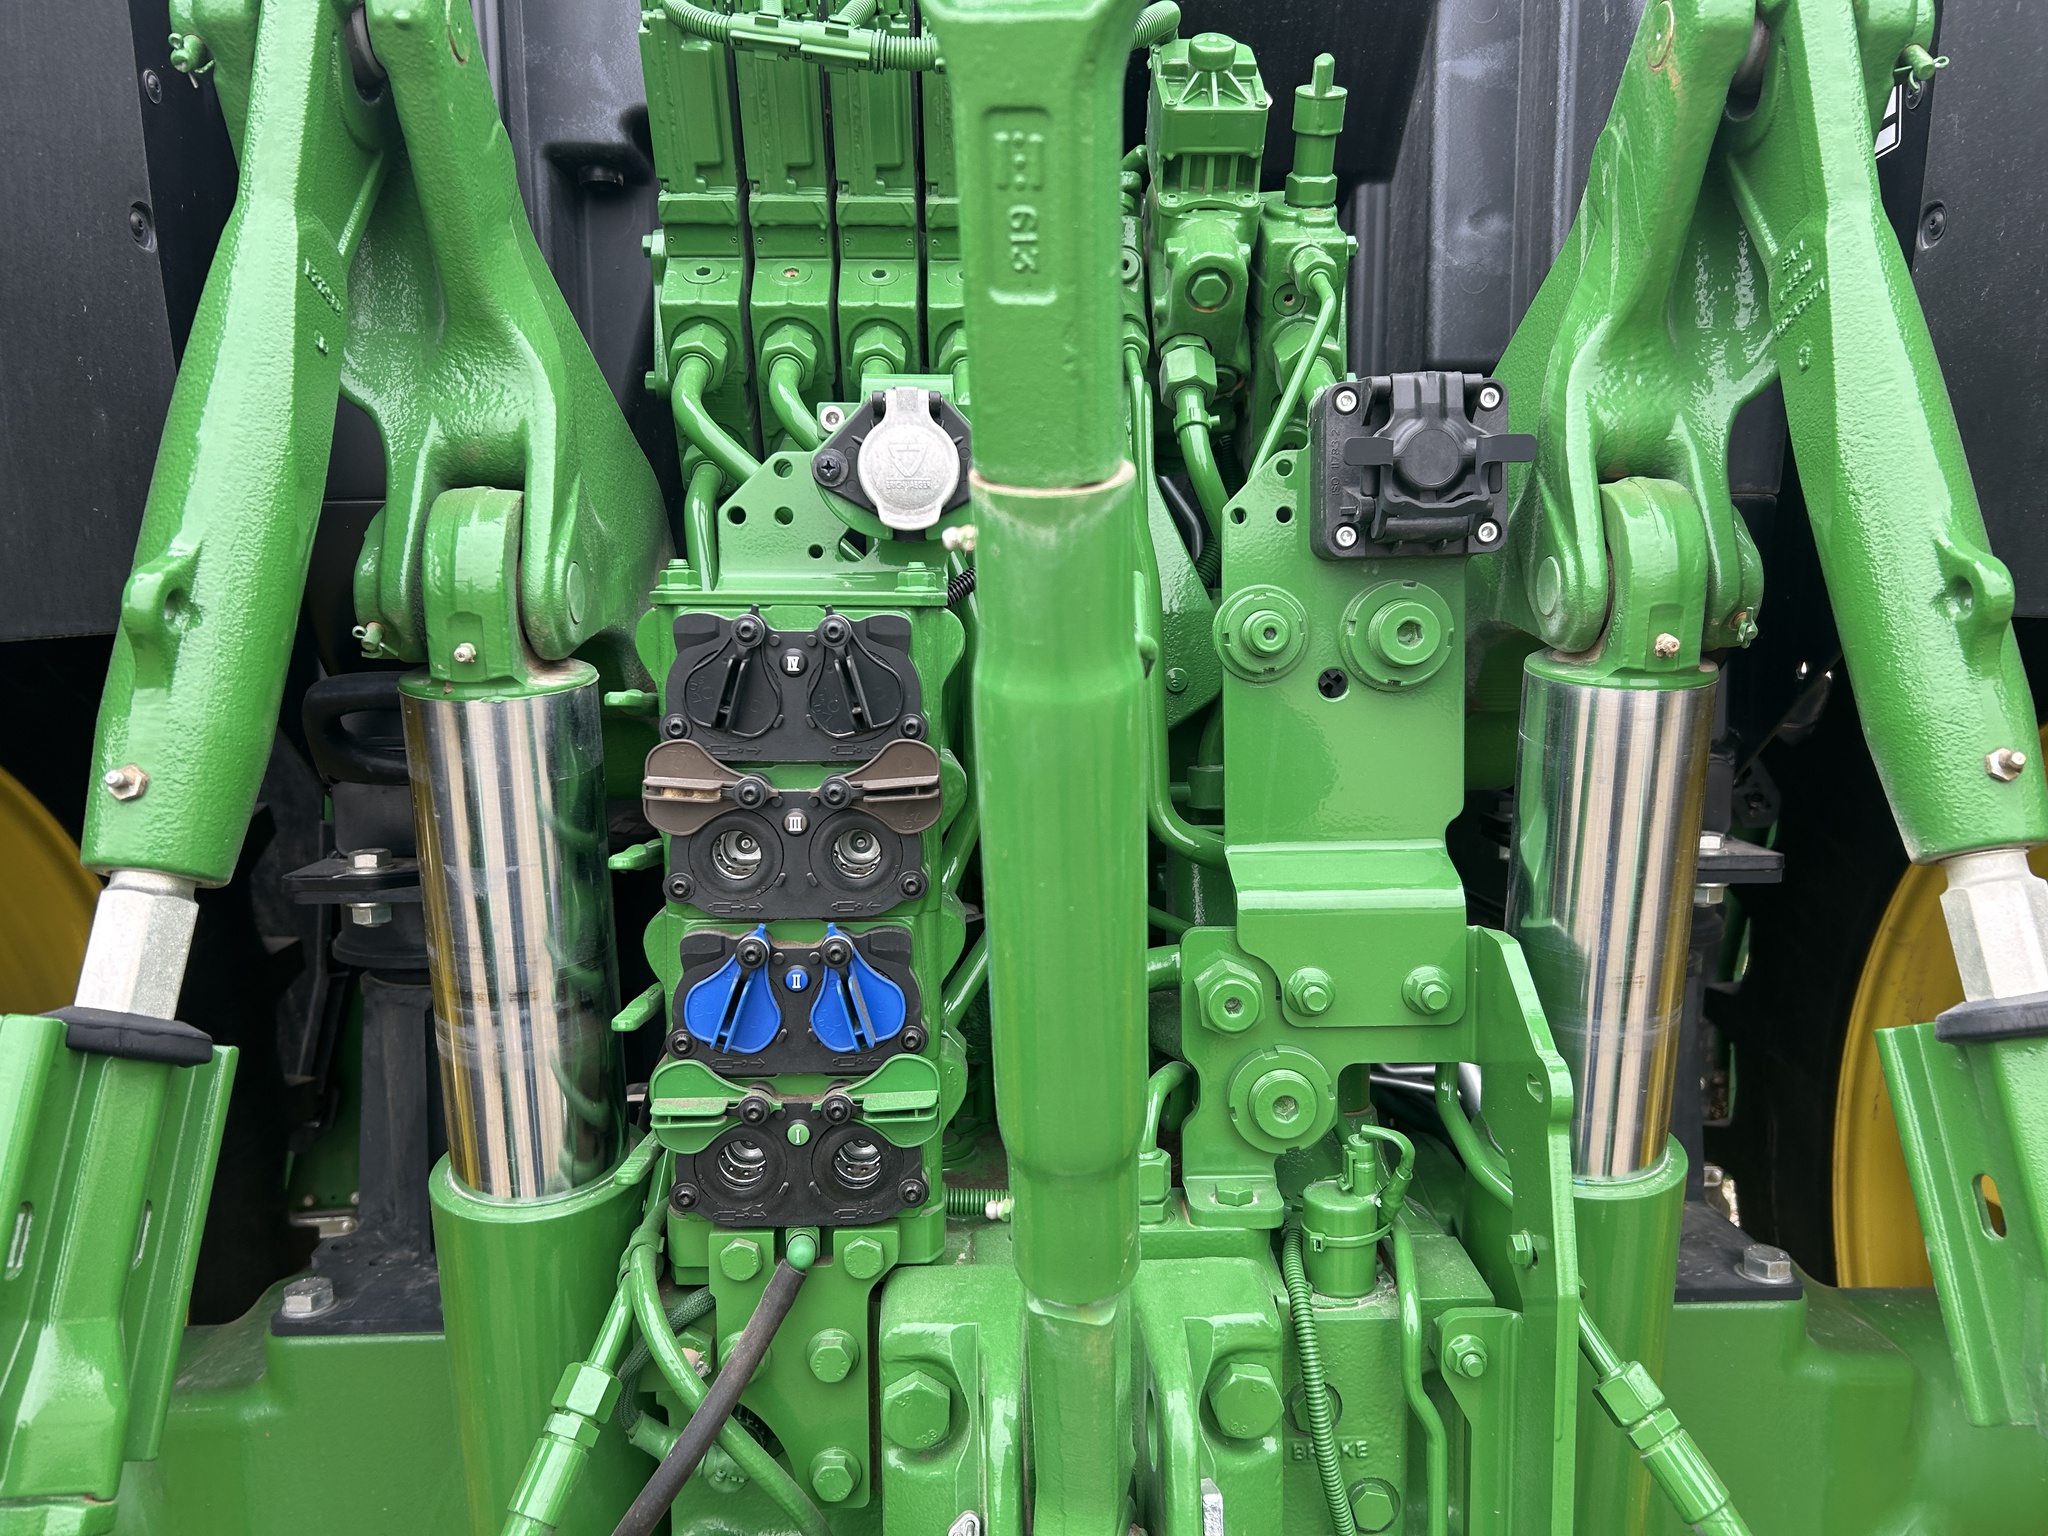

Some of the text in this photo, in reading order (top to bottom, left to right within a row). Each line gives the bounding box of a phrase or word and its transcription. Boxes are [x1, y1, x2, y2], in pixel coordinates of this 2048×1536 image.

[1331, 476, 1340, 496] ISO
[786, 656, 800, 672] IV
[788, 817, 803, 832] III
[792, 974, 802, 989] II
[795, 1129, 801, 1144] I
[1292, 1440, 1369, 1461] BRKE
